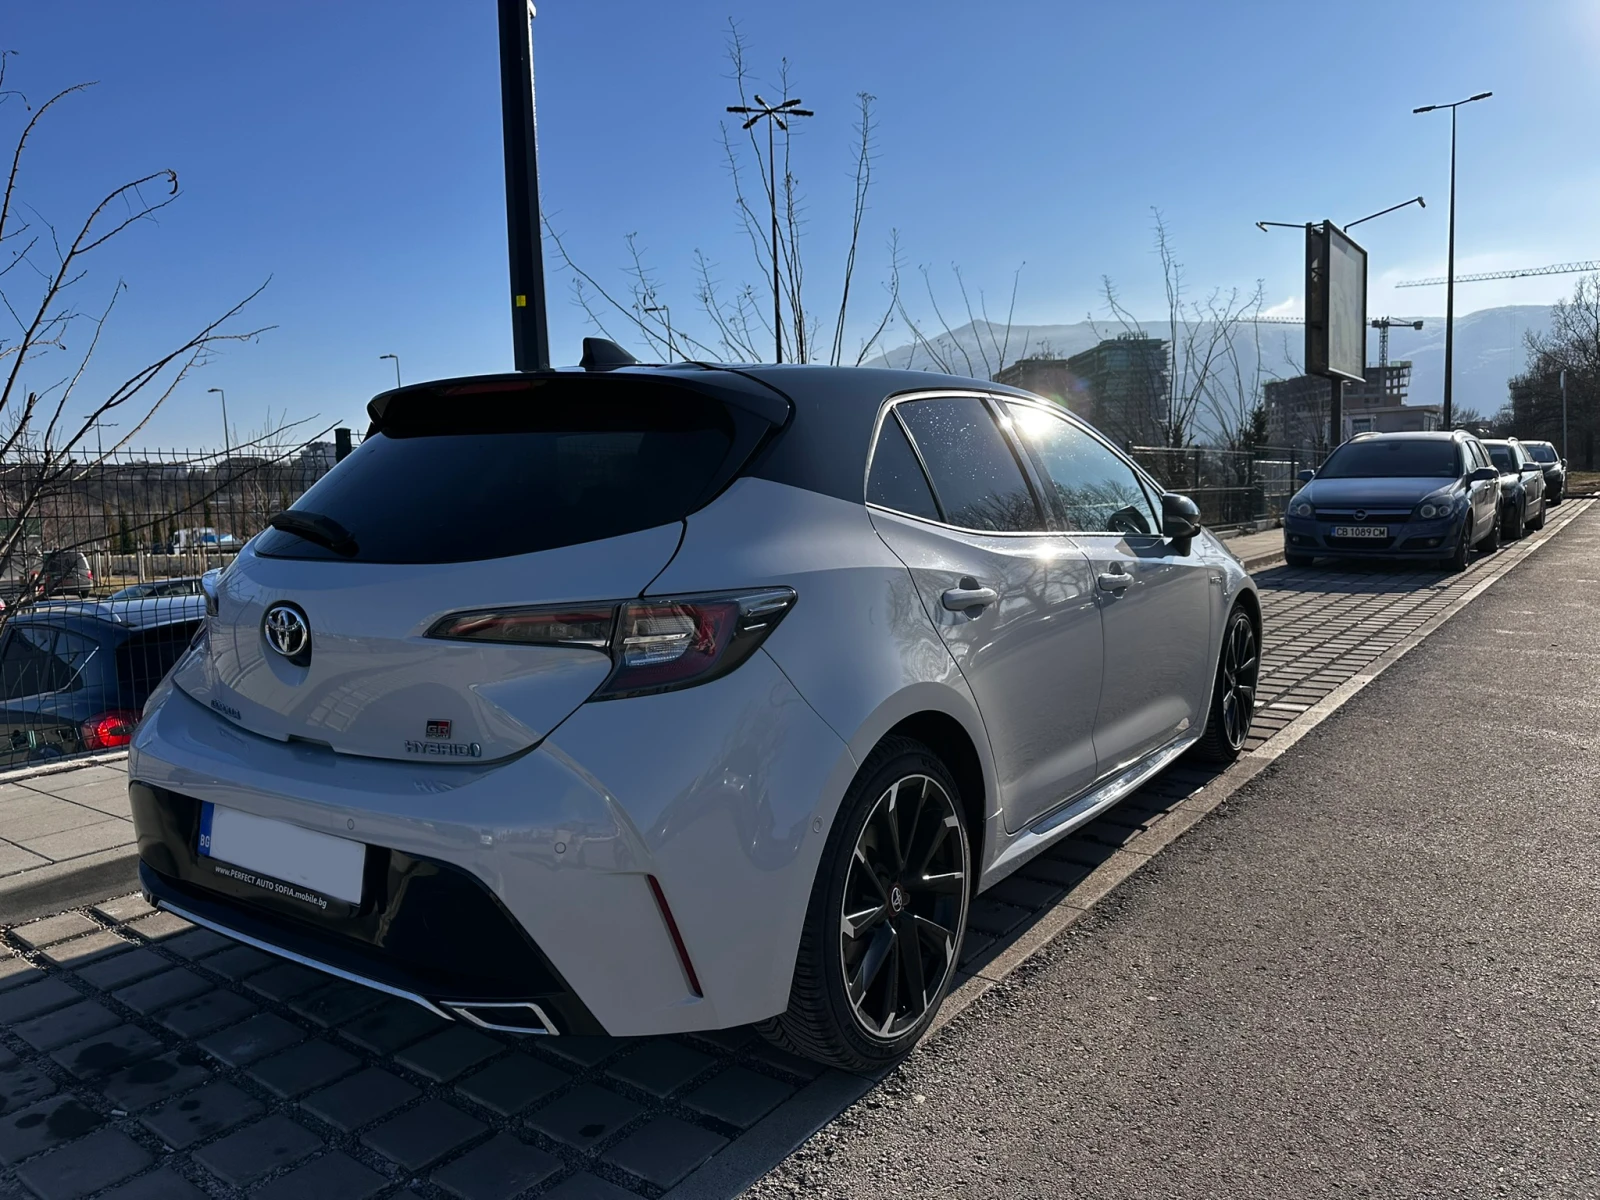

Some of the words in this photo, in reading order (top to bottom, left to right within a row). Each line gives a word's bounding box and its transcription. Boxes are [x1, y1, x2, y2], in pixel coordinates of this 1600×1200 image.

[1336, 527, 1348, 536] CB
[1350, 527, 1372, 537] 1089
[1373, 528, 1386, 537] CM
[427, 725, 448, 734] GR
[404, 740, 470, 757] HYBRID
[200, 834, 210, 848] BG
[215, 866, 255, 884] www.PERFECT
[256, 878, 274, 890] AUTO
[275, 883, 328, 910] SOFIA.mobile.bg
